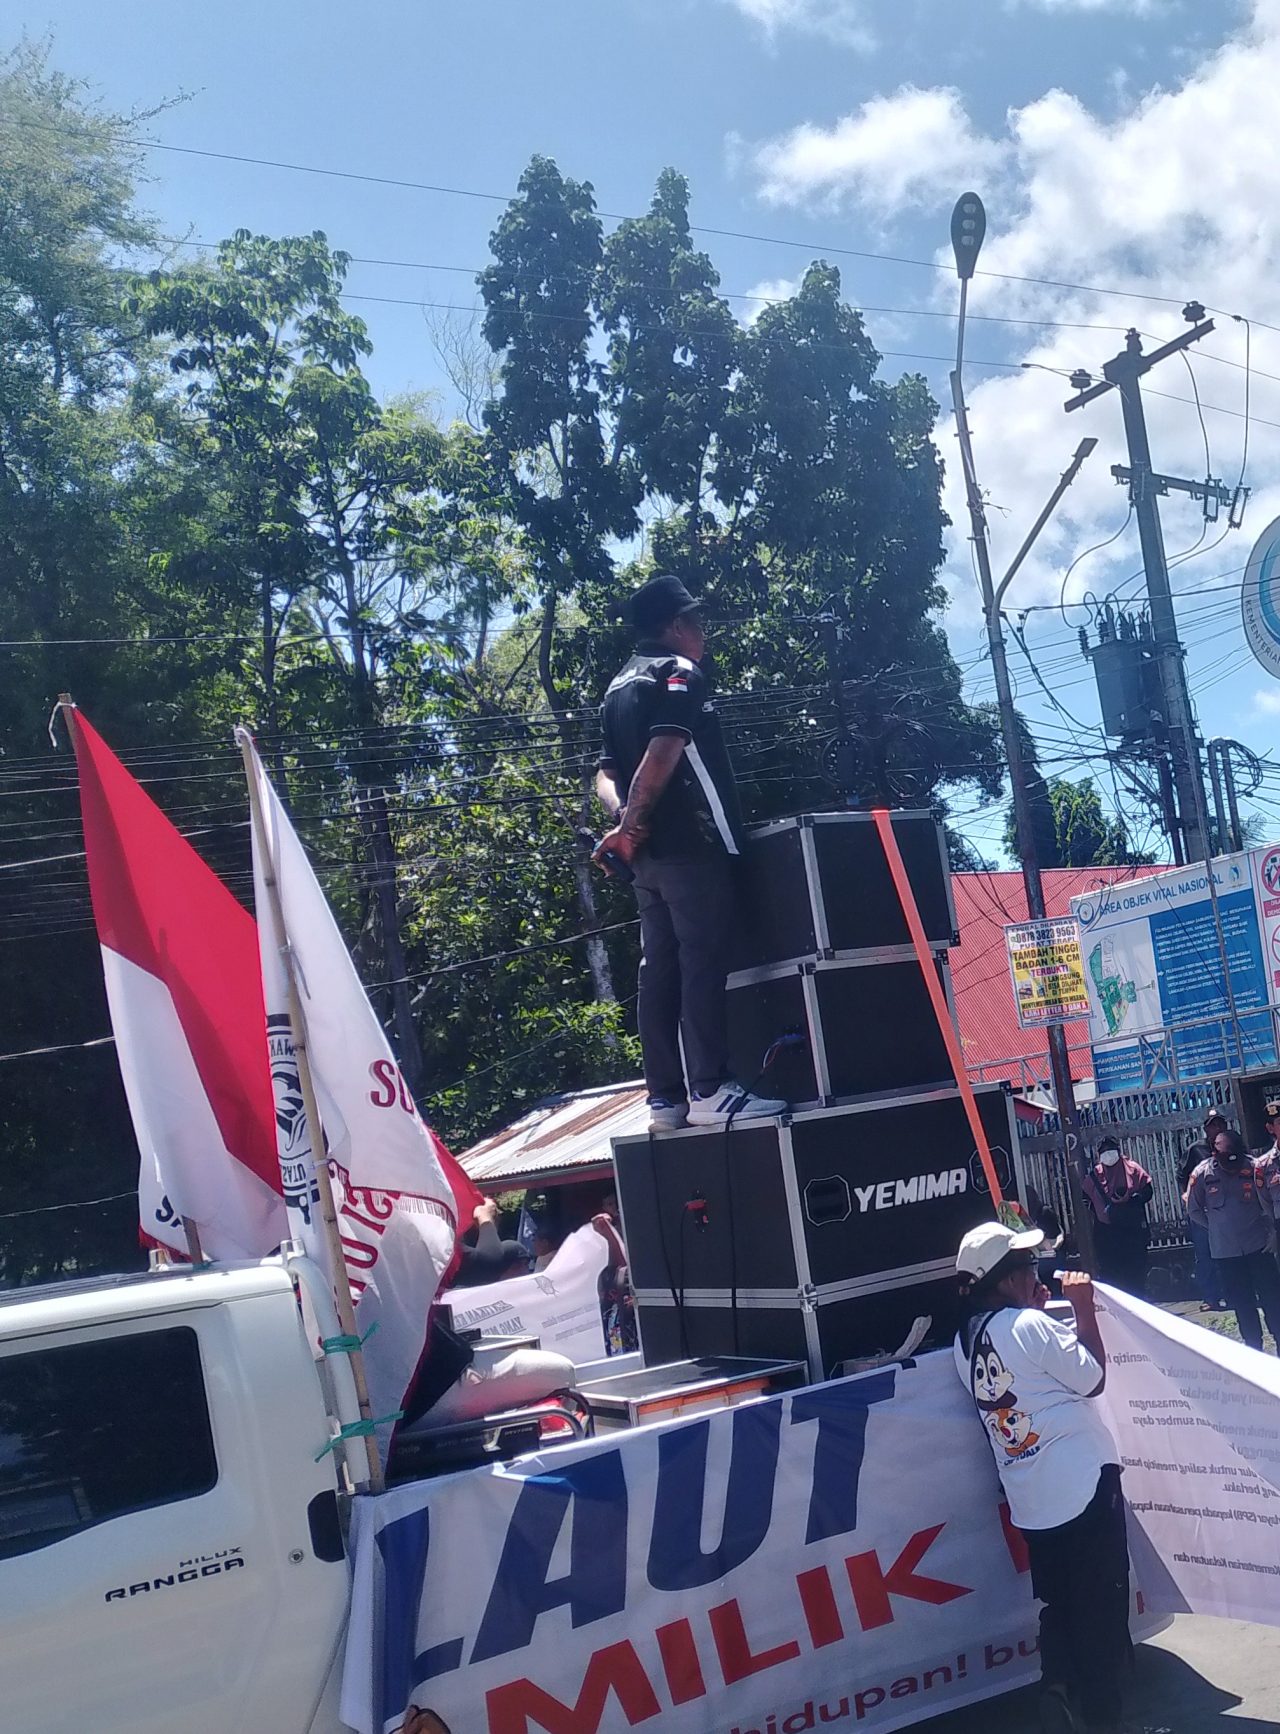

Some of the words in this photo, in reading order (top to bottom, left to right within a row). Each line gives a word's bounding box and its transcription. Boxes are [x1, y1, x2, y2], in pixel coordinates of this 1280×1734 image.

[1099, 901, 1122, 915] AREA
[1123, 892, 1153, 910] OBJEK
[1152, 886, 1178, 902] VITAL
[1013, 948, 1048, 961] TAMBAH
[1049, 943, 1079, 956] TINGGI
[1015, 958, 1048, 971] BADAN
[1066, 953, 1080, 963] CM
[1031, 965, 1069, 977] TERBUKTI
[853, 1167, 968, 1212] YEMIMA
[179, 1546, 243, 1569] HILUX
[375, 1368, 897, 1726] LAUT
[104, 1556, 246, 1603] RANGGA
[485, 1521, 975, 1734] MILIK
